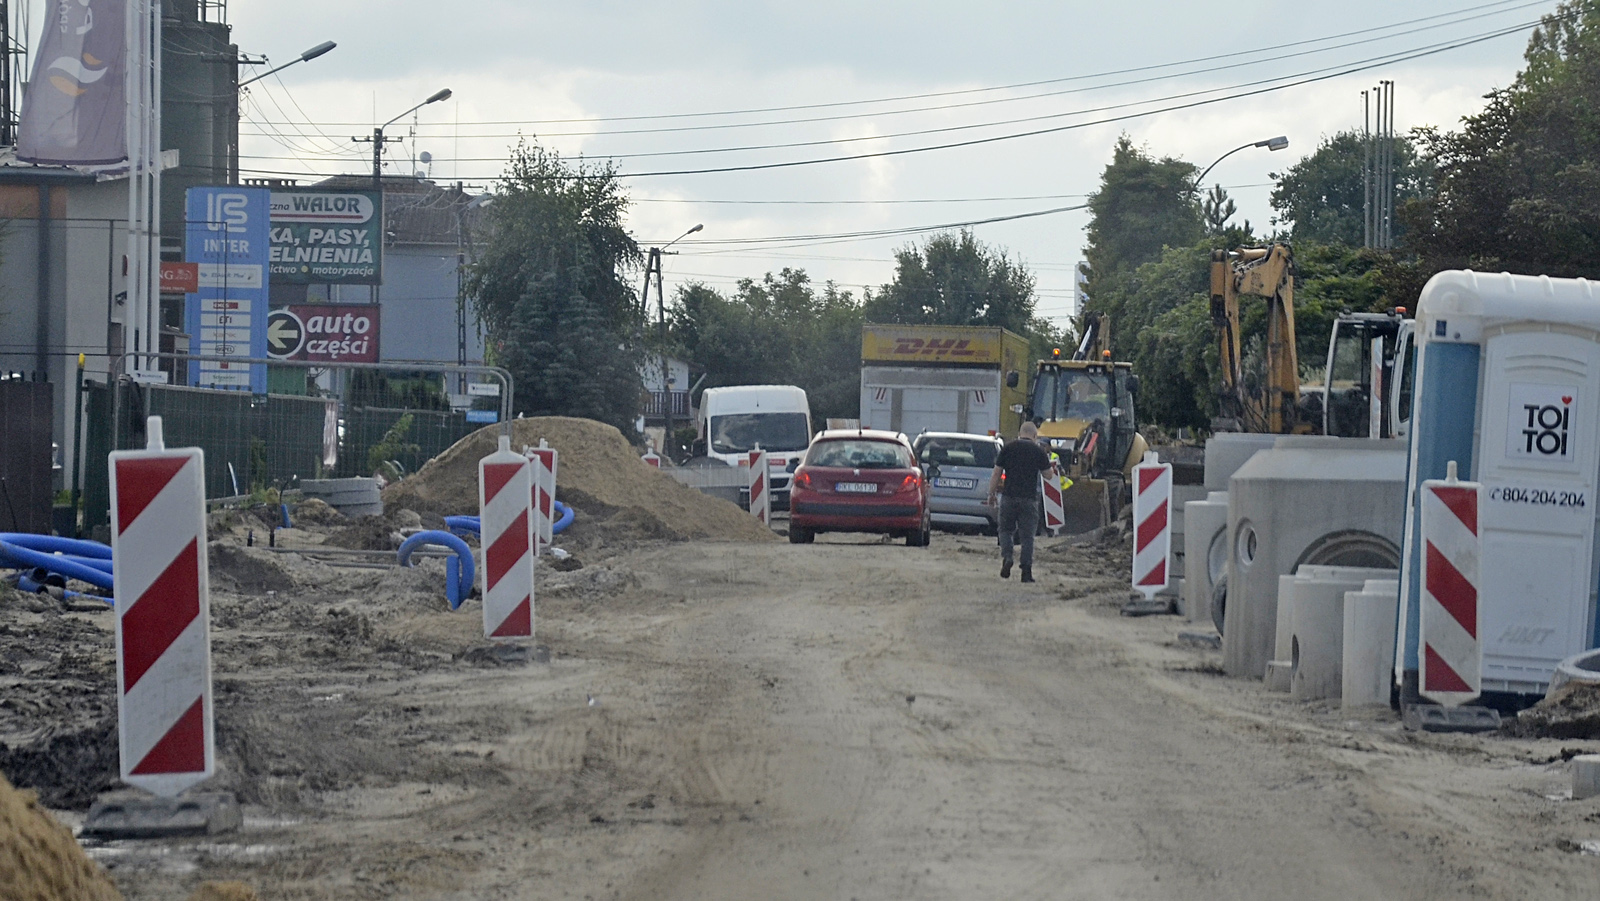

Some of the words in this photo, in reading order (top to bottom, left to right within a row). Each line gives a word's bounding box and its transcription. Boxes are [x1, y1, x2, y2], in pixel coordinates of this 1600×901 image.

[292, 196, 361, 214] WALOR
[204, 239, 249, 253] INTER
[308, 228, 370, 248] PASY,
[312, 265, 375, 277] motoryzacja
[306, 312, 370, 335] auto
[305, 335, 370, 359] części
[893, 338, 975, 356] DHL
[1523, 403, 1570, 431] TOI
[1522, 428, 1568, 456] TOI
[1502, 486, 1529, 503] 804
[1531, 489, 1557, 505] 204
[1559, 490, 1585, 508] 204
